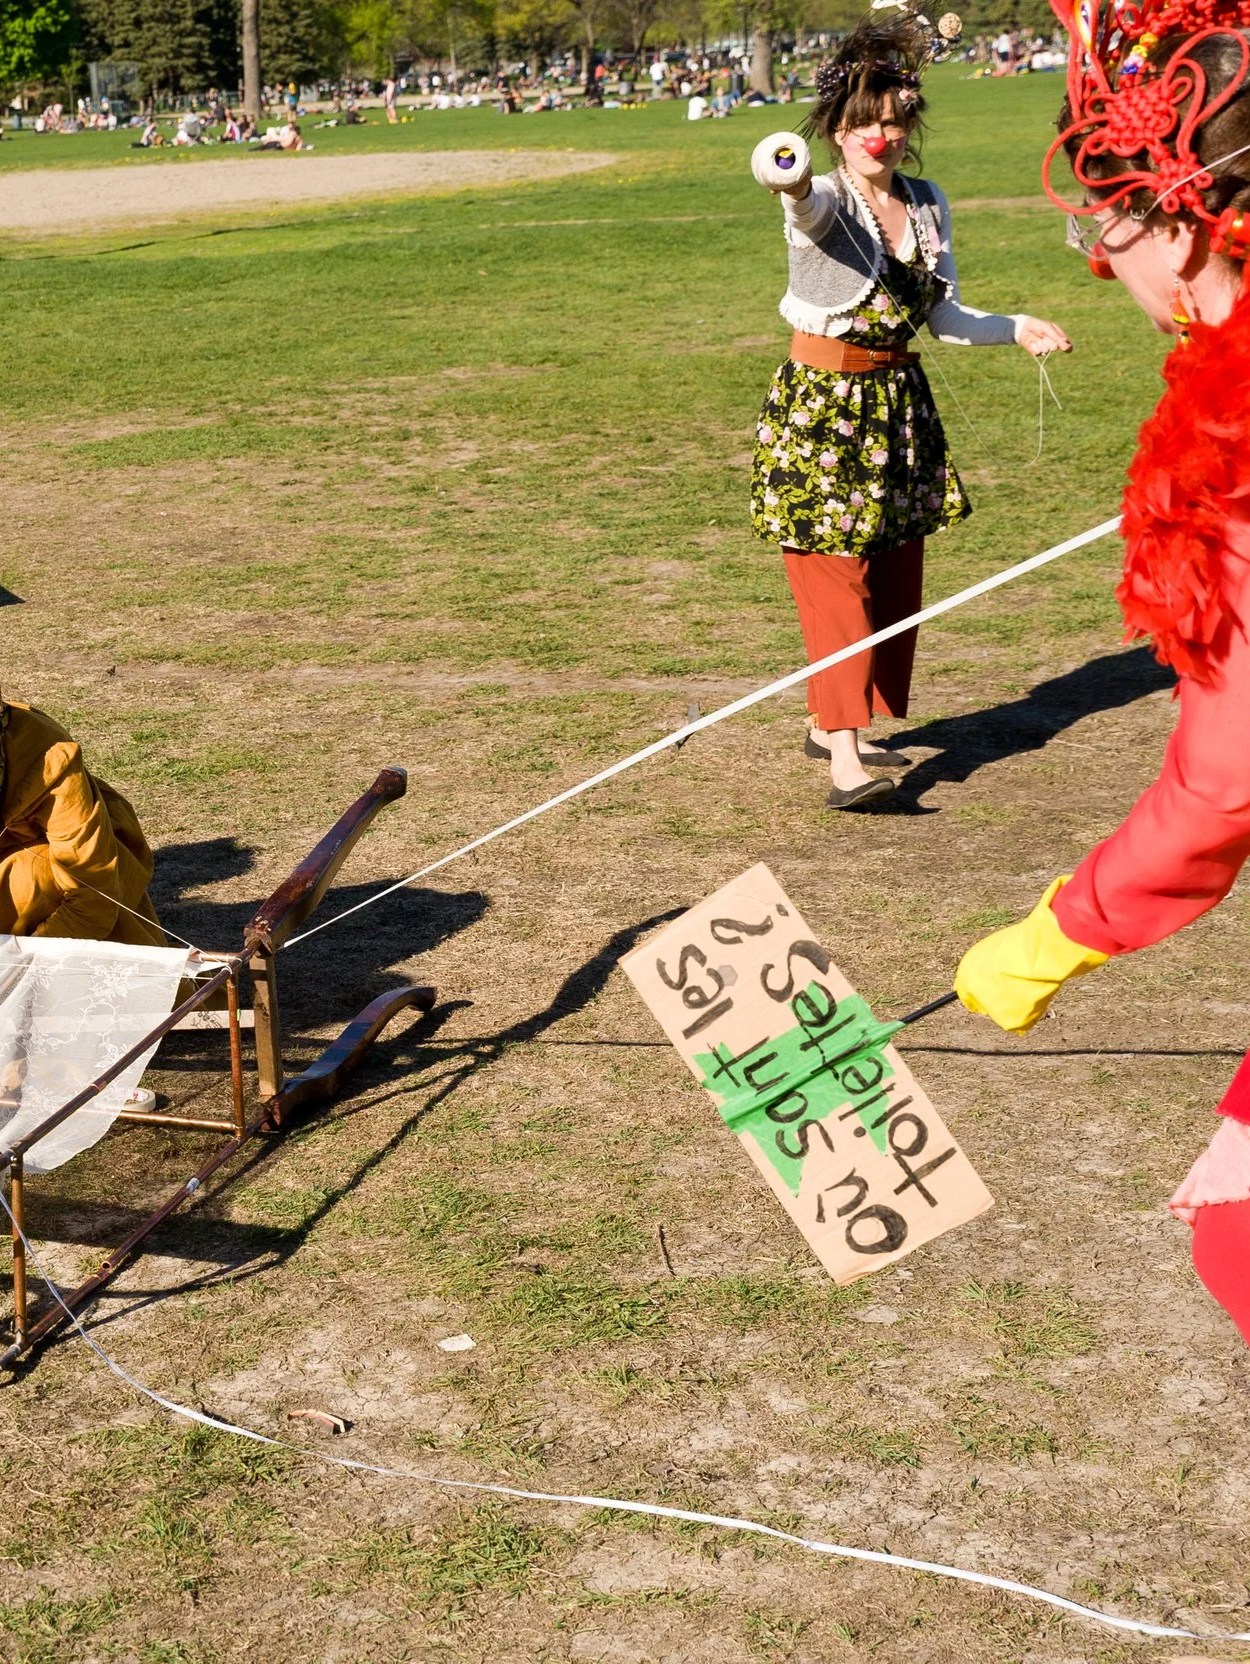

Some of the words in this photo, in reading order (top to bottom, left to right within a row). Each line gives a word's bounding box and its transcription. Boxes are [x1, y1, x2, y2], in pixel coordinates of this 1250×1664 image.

[710, 903, 789, 945] ?
[656, 943, 734, 1039] les
[760, 939, 957, 1208] toilettes
